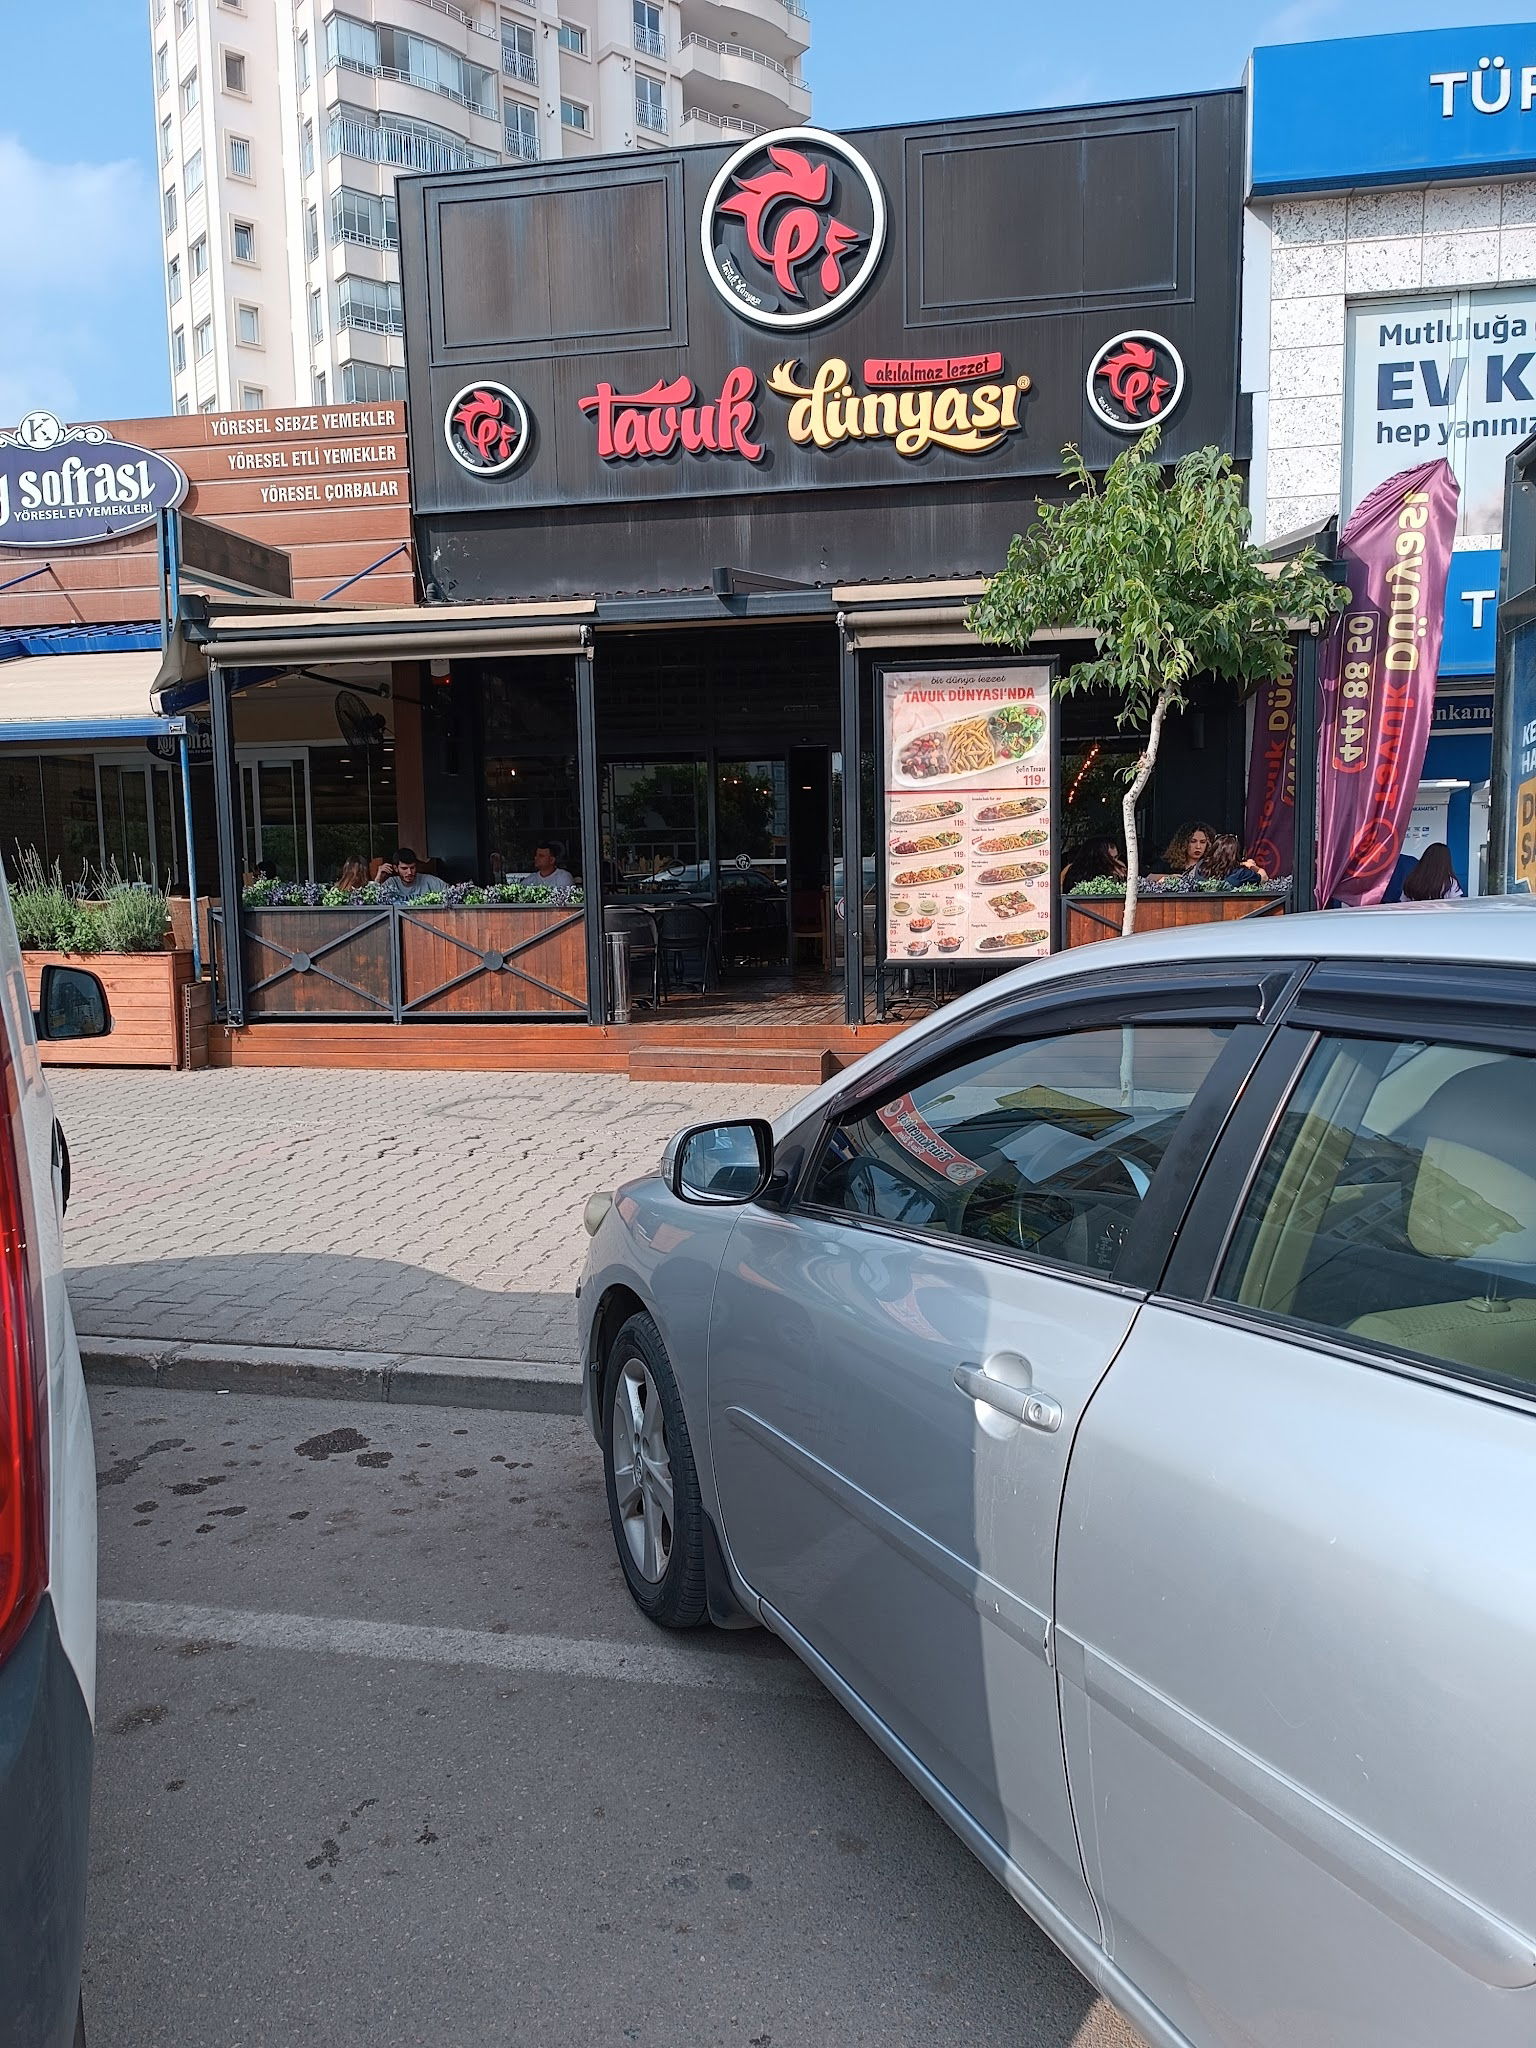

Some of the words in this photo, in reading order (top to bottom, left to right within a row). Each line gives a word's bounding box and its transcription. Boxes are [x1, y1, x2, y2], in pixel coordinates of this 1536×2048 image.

[1379, 314, 1527, 346] Mutluluğa
[876, 362, 943, 382] akılalmaz
[946, 356, 990, 379] lezzet
[1377, 357, 1468, 411] EV
[581, 366, 761, 460] tavuk
[767, 358, 1018, 454] dünyası
[211, 417, 271, 436] YÖRESEL
[275, 415, 318, 432] SEBZE
[322, 410, 395, 429] YEMEKLER
[1377, 421, 1430, 447] hep
[228, 452, 288, 470] YÖRESEL
[292, 447, 319, 466] ETLİ
[323, 445, 396, 464] YEMEKLER
[18, 456, 155, 509] sofrası
[261, 484, 321, 503] YÖRESEL
[325, 480, 398, 502] ÇORBALAR
[14, 508, 66, 522] YÖRESEL
[69, 508, 83, 519] EV
[84, 501, 152, 517] YEMEKLERİ
[903, 689, 946, 703] TAVUK
